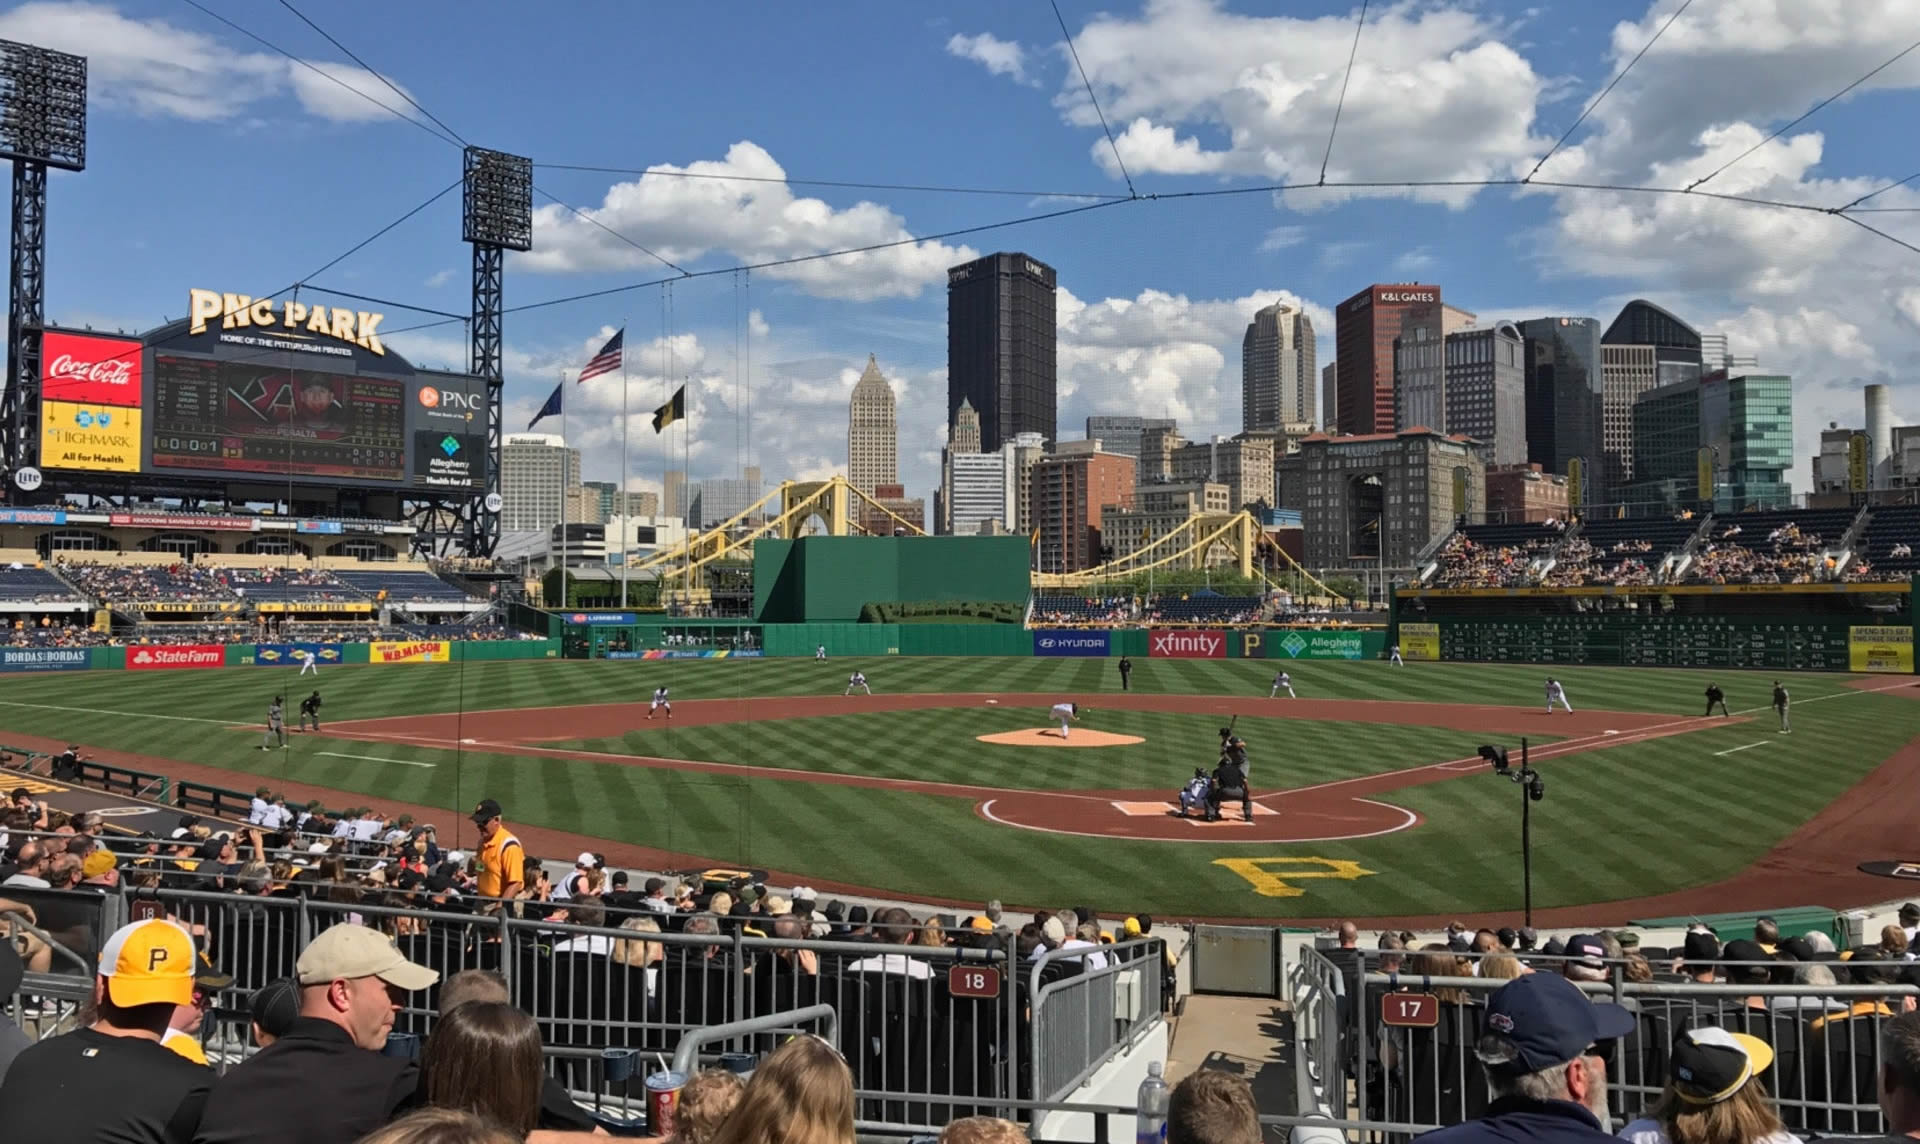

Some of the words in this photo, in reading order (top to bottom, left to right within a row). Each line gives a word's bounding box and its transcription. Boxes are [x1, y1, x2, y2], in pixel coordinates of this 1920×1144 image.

[1381, 292, 1400, 302] K&L
[1401, 293, 1434, 302] GATES
[189, 288, 276, 336] PNC
[284, 301, 384, 356] PARK
[220, 334, 244, 344] HOME
[244, 336, 256, 344] OF
[258, 338, 273, 347] THE
[322, 346, 352, 356] PIRATES
[441, 391, 480, 410] PNC
[56, 430, 130, 448] HIGHMARK
[62, 452, 76, 461] All
[78, 453, 91, 462] for
[94, 454, 124, 464] Health
[430, 458, 470, 470] Allegheny
[19, 472, 40, 484] Lite
[426, 476, 450, 485] Health
[450, 478, 460, 486] for
[161, 603, 188, 611] CITY
[192, 603, 222, 611] BEER
[1058, 639, 1105, 647] HYUNDAI
[1154, 631, 1221, 656] xfinity
[1244, 634, 1260, 656] P
[1310, 637, 1360, 650] Allegheny
[5, 652, 42, 662] BORDAS
[48, 651, 85, 661] BORDAS
[1210, 856, 1380, 897] P
[142, 907, 154, 920] 18
[148, 948, 168, 971] P
[965, 973, 984, 989] 18
[1400, 1001, 1422, 1017] 17
